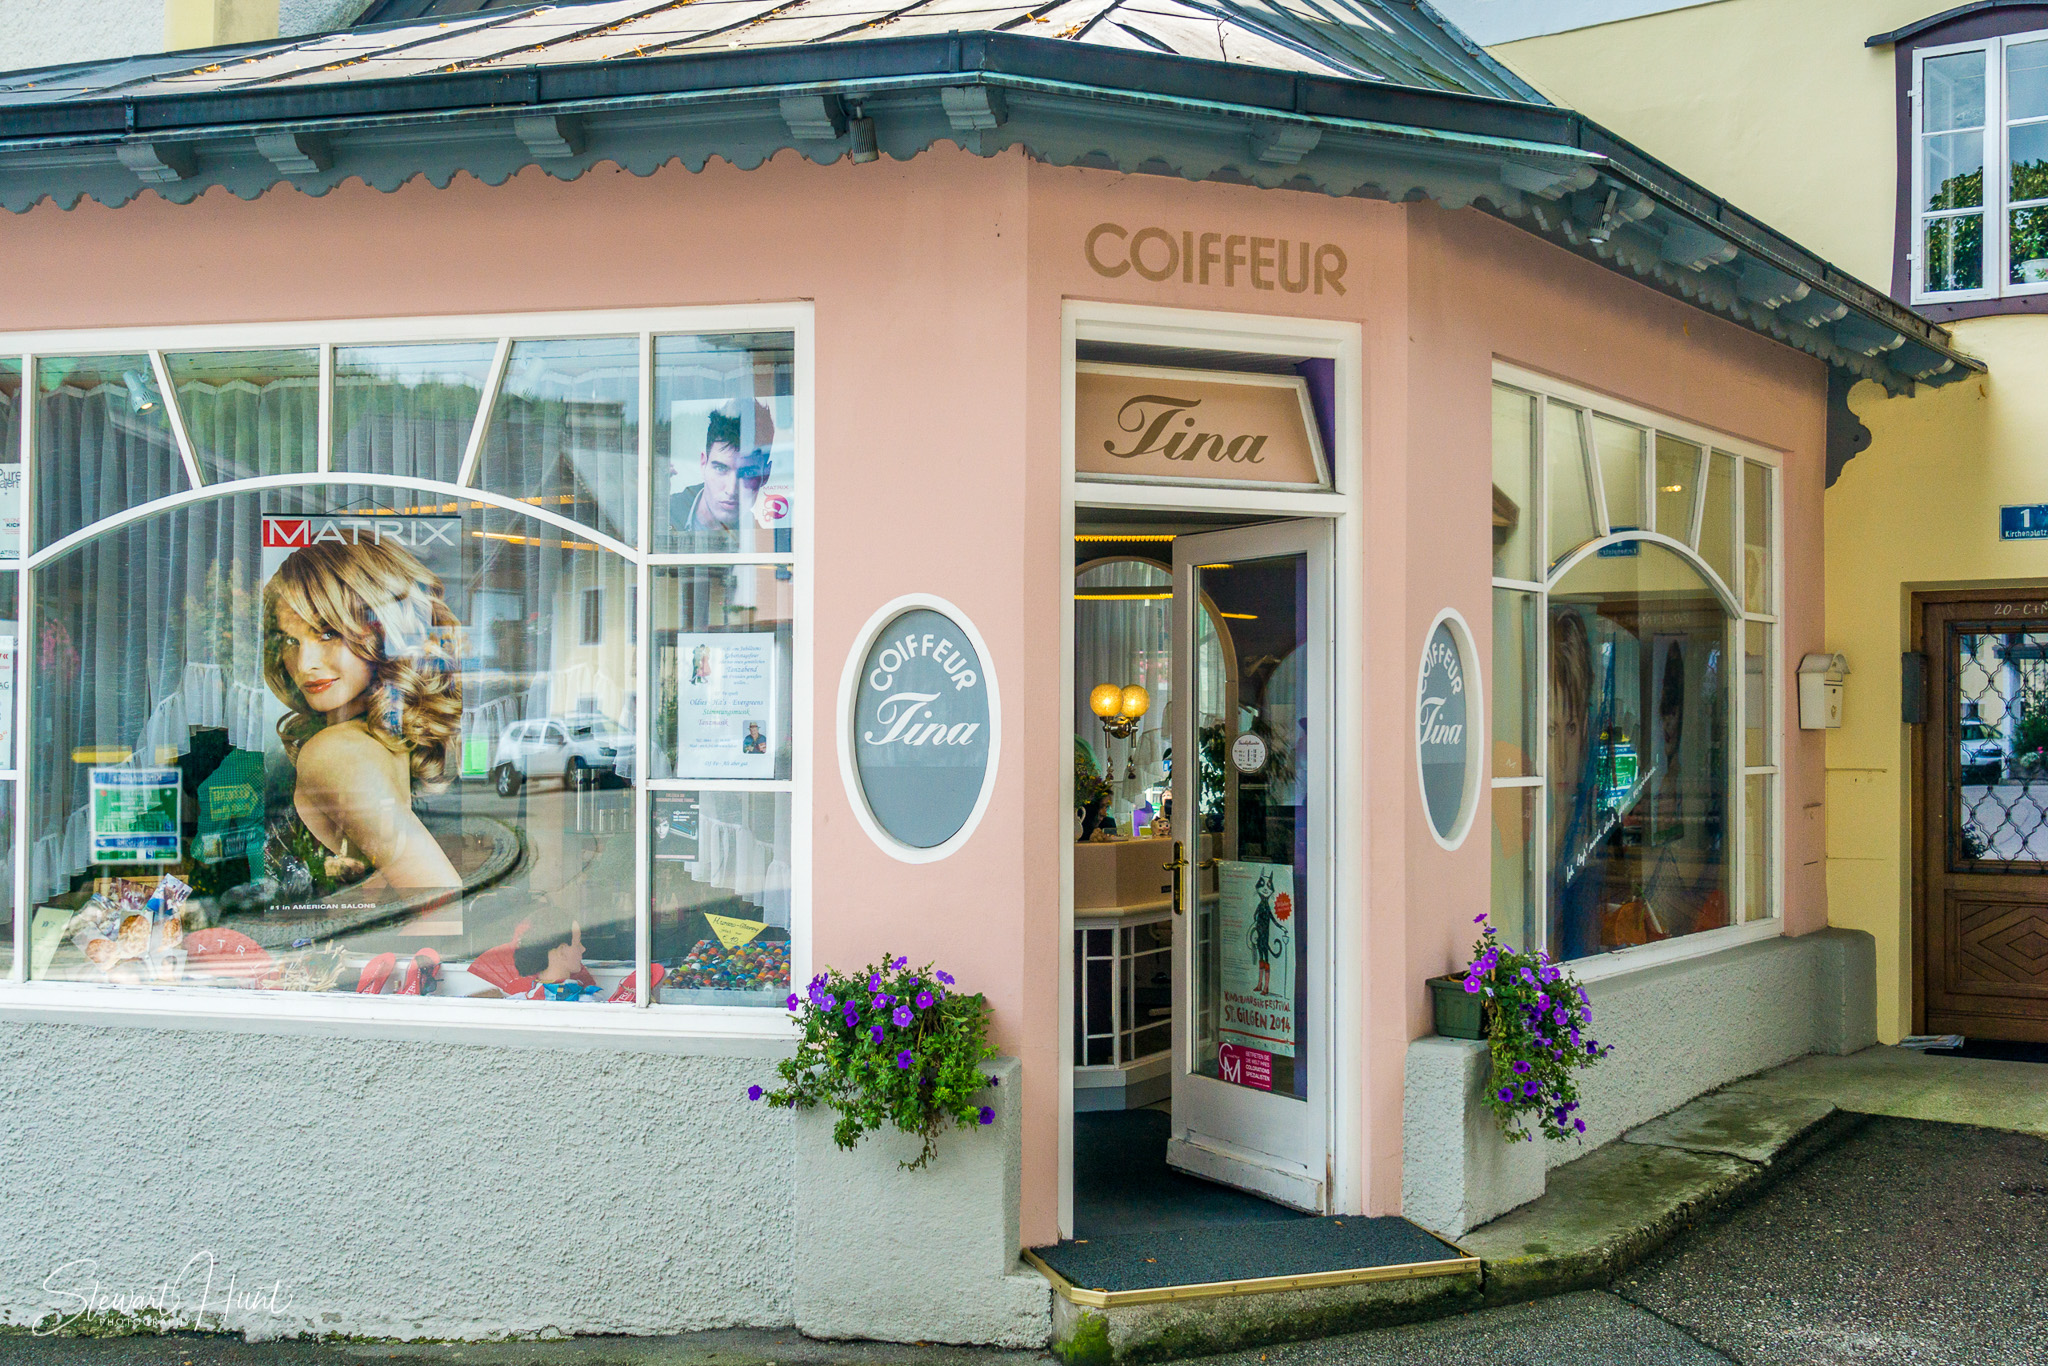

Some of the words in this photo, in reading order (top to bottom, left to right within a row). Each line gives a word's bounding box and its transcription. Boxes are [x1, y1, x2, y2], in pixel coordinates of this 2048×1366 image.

[1084, 222, 1348, 297] COIFFEUR
[1103, 394, 1269, 464] Tina
[269, 520, 456, 547] MATRIX
[2005, 529, 2048, 538] Kirchenplatz
[2020, 508, 2031, 528] 1
[870, 634, 977, 691] COIFFEUR
[864, 692, 980, 746] Tina
[1420, 696, 1463, 745] Tina
[292, 903, 339, 911] AMERICAN
[1270, 1014, 1291, 1033] 2014
